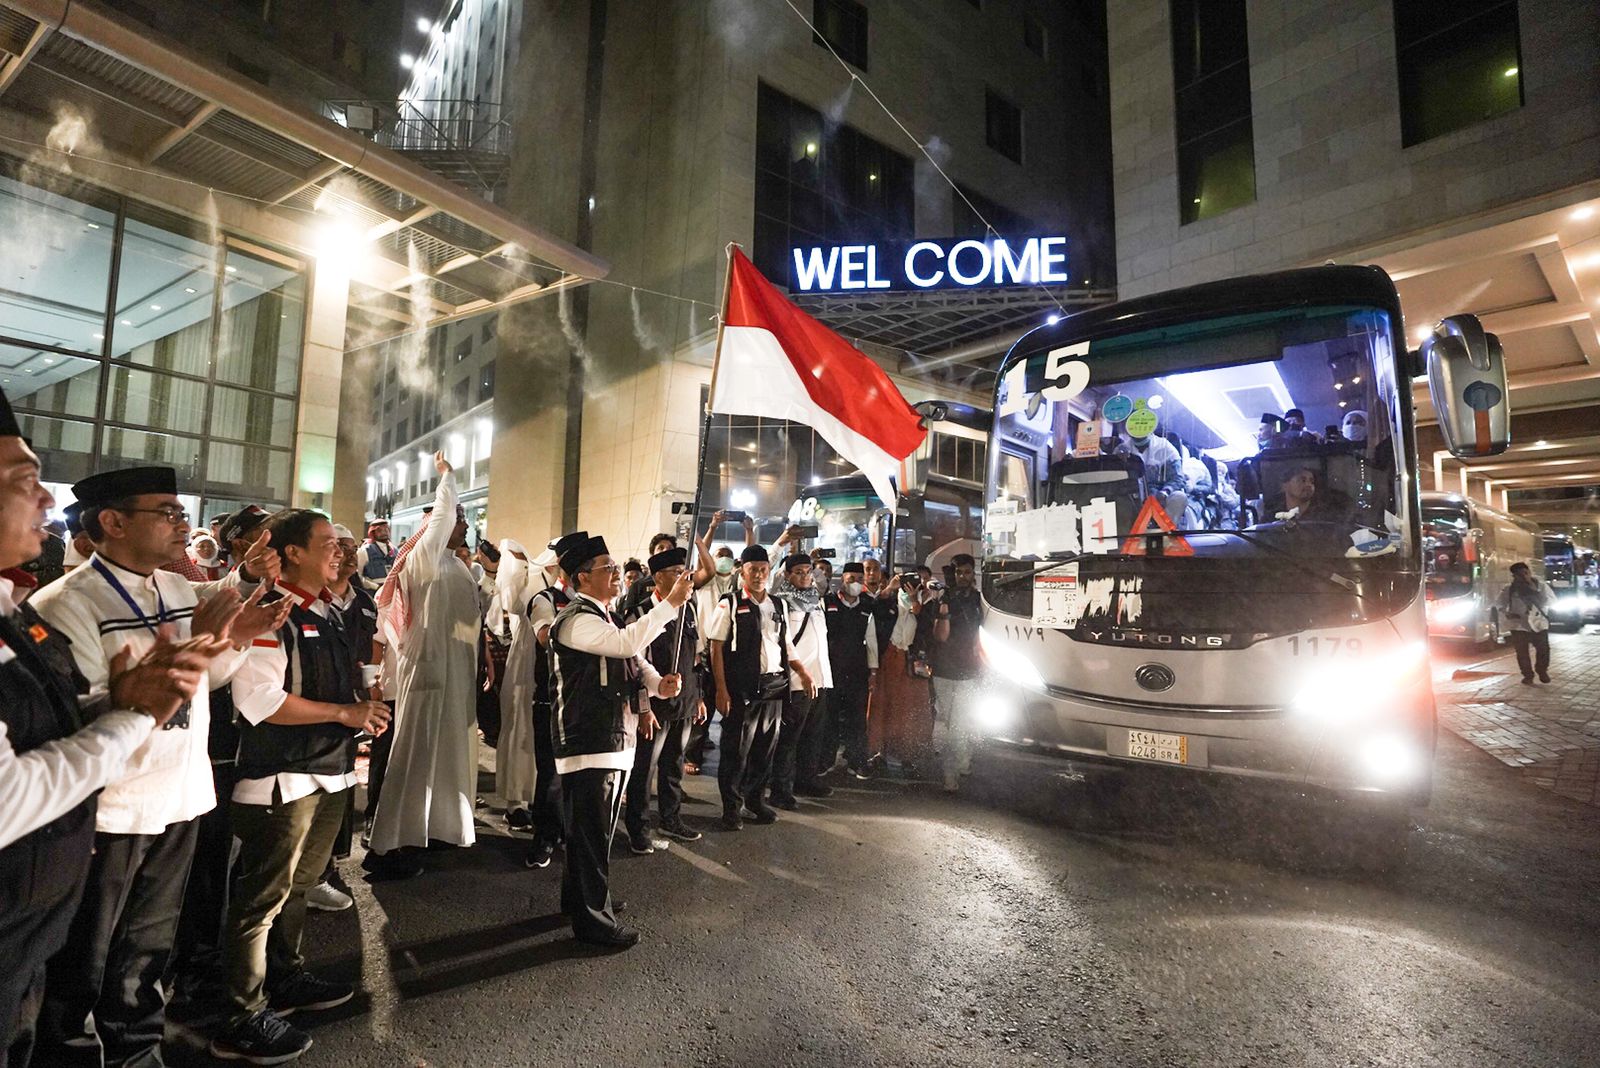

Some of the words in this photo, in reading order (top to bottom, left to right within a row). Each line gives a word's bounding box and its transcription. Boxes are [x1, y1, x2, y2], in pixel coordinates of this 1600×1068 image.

[1091, 518, 1105, 544] 1
[1005, 625, 1045, 642] ١١٧٩
[1091, 631, 1223, 646] YUTONG
[1287, 635, 1364, 657] 1179
[1130, 745, 1157, 759] 4248
[1160, 750, 1179, 760] SRA
